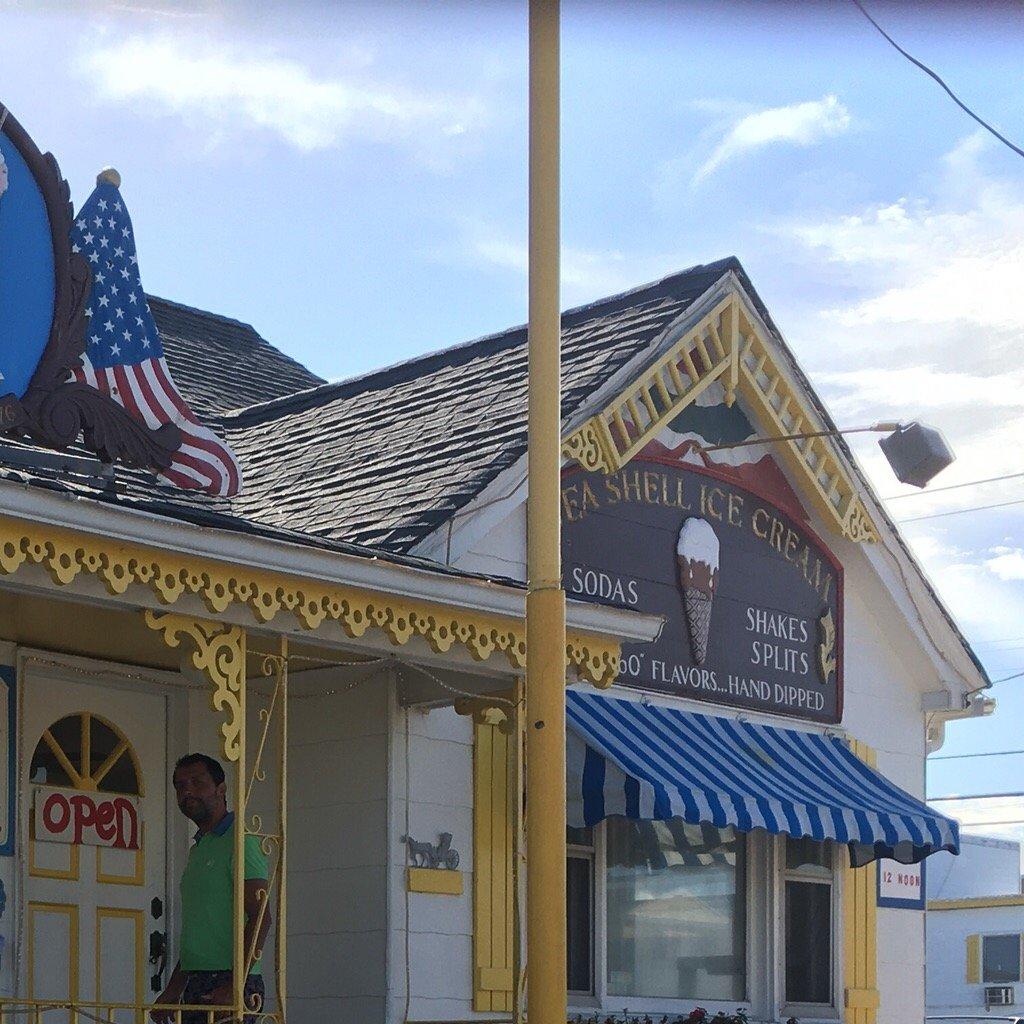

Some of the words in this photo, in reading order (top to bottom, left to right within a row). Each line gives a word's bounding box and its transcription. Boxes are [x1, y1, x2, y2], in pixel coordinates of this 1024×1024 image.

[561, 480, 600, 521] EA
[605, 470, 692, 510] SHELL
[700, 482, 745, 528] ICE
[751, 508, 833, 604] CREAM
[572, 567, 639, 605] SODAS
[745, 607, 808, 643] SHAKES
[751, 641, 809, 675] SPLITS
[775, 683, 825, 711] DIPPED
[883, 871, 892, 883] 12
[898, 873, 921, 886] NOON
